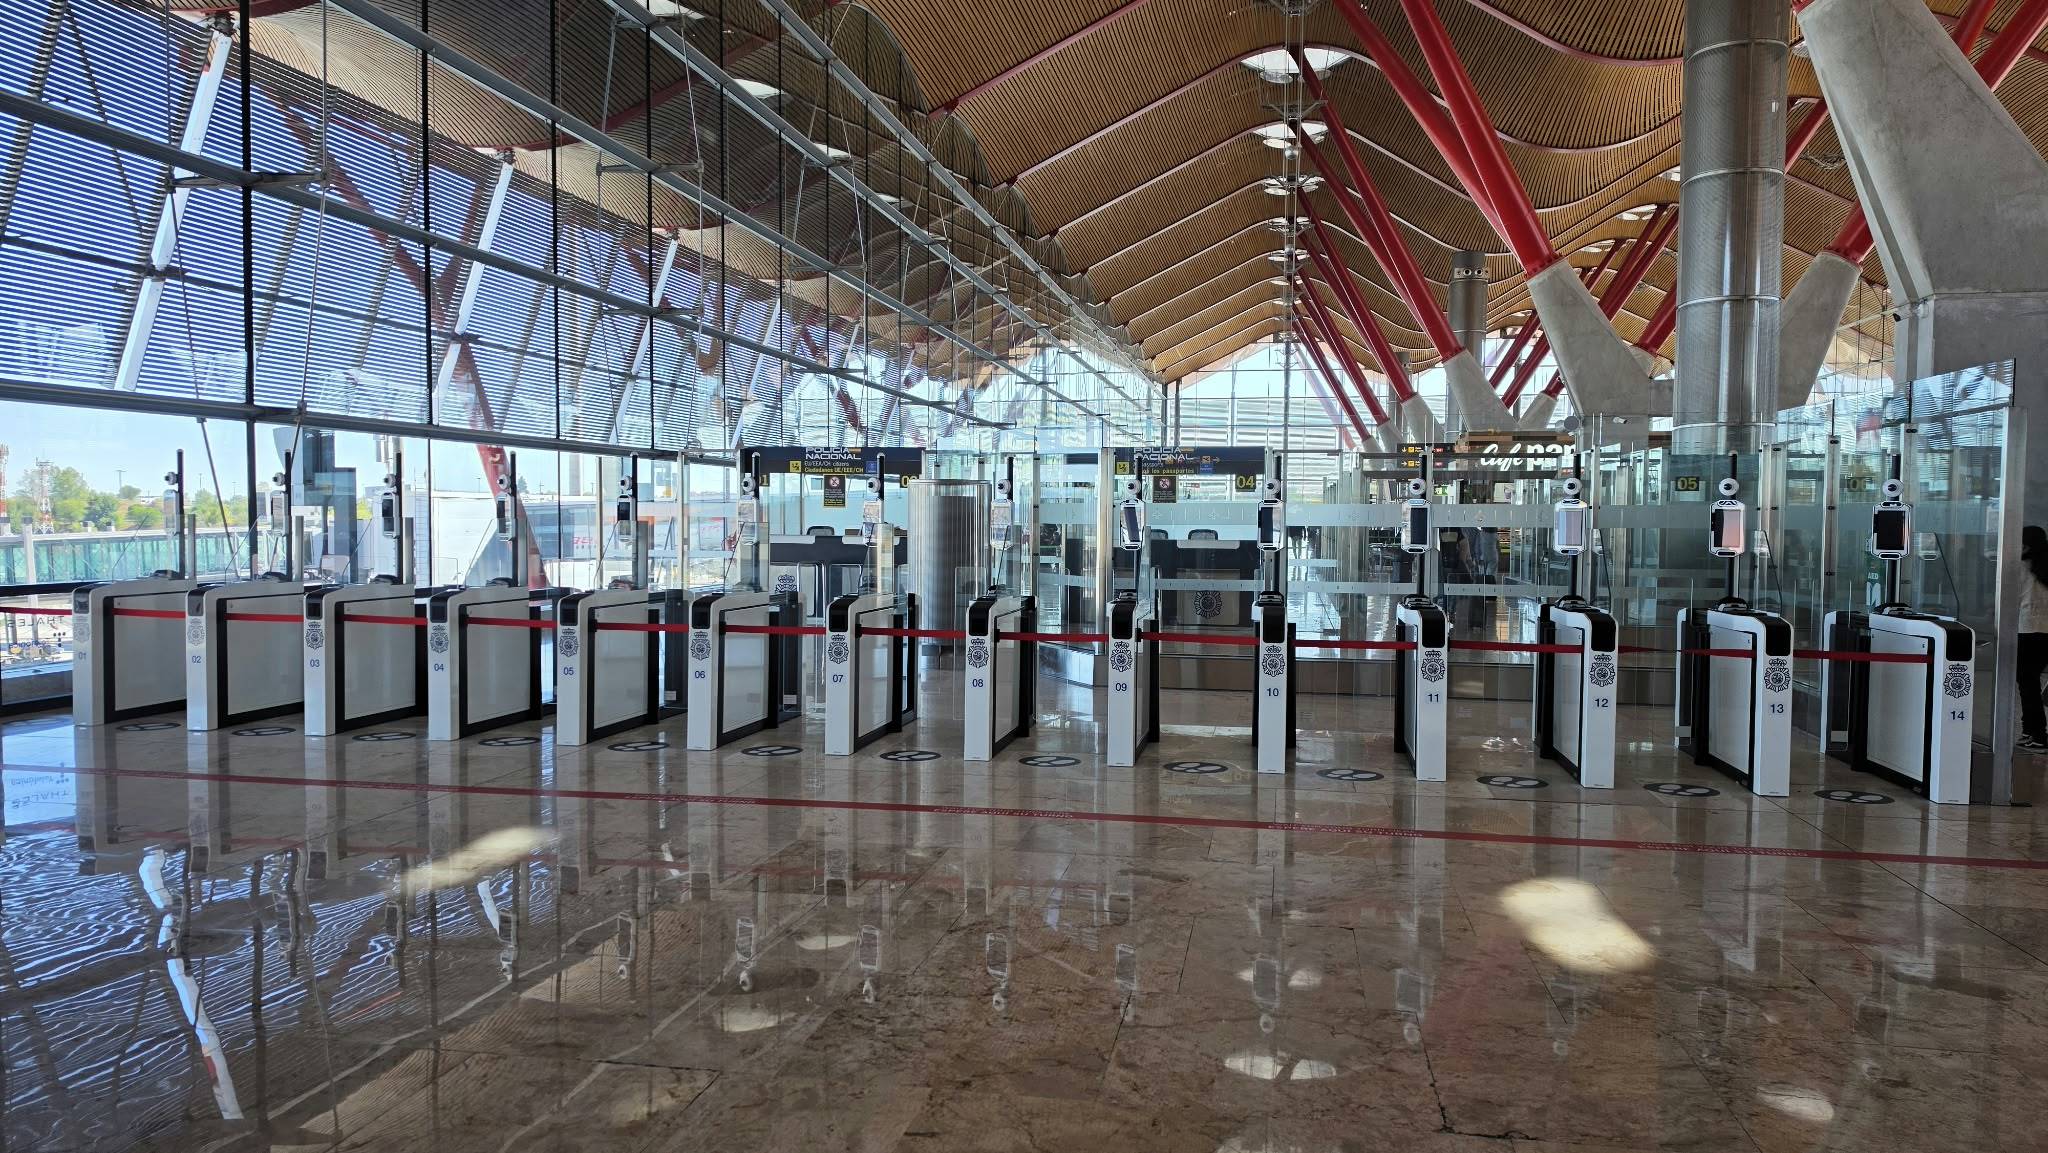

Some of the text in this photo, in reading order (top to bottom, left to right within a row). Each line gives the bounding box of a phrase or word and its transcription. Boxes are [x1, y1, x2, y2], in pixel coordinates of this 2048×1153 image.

[759, 474, 769, 486] 1
[1236, 475, 1255, 488] 04
[1677, 477, 1698, 490] 05
[191, 656, 201, 664] 02
[309, 659, 320, 668] 03
[433, 663, 444, 672] 04
[563, 666, 574, 676] 05
[694, 670, 706, 679] 06
[832, 674, 844, 683] 07
[972, 678, 984, 688] 08
[1115, 682, 1127, 692] 09
[1266, 687, 1279, 697] 10
[1427, 693, 1440, 703] 11
[1594, 698, 1609, 708] 12
[1770, 703, 1785, 714] 13
[1950, 710, 1966, 721] 14
